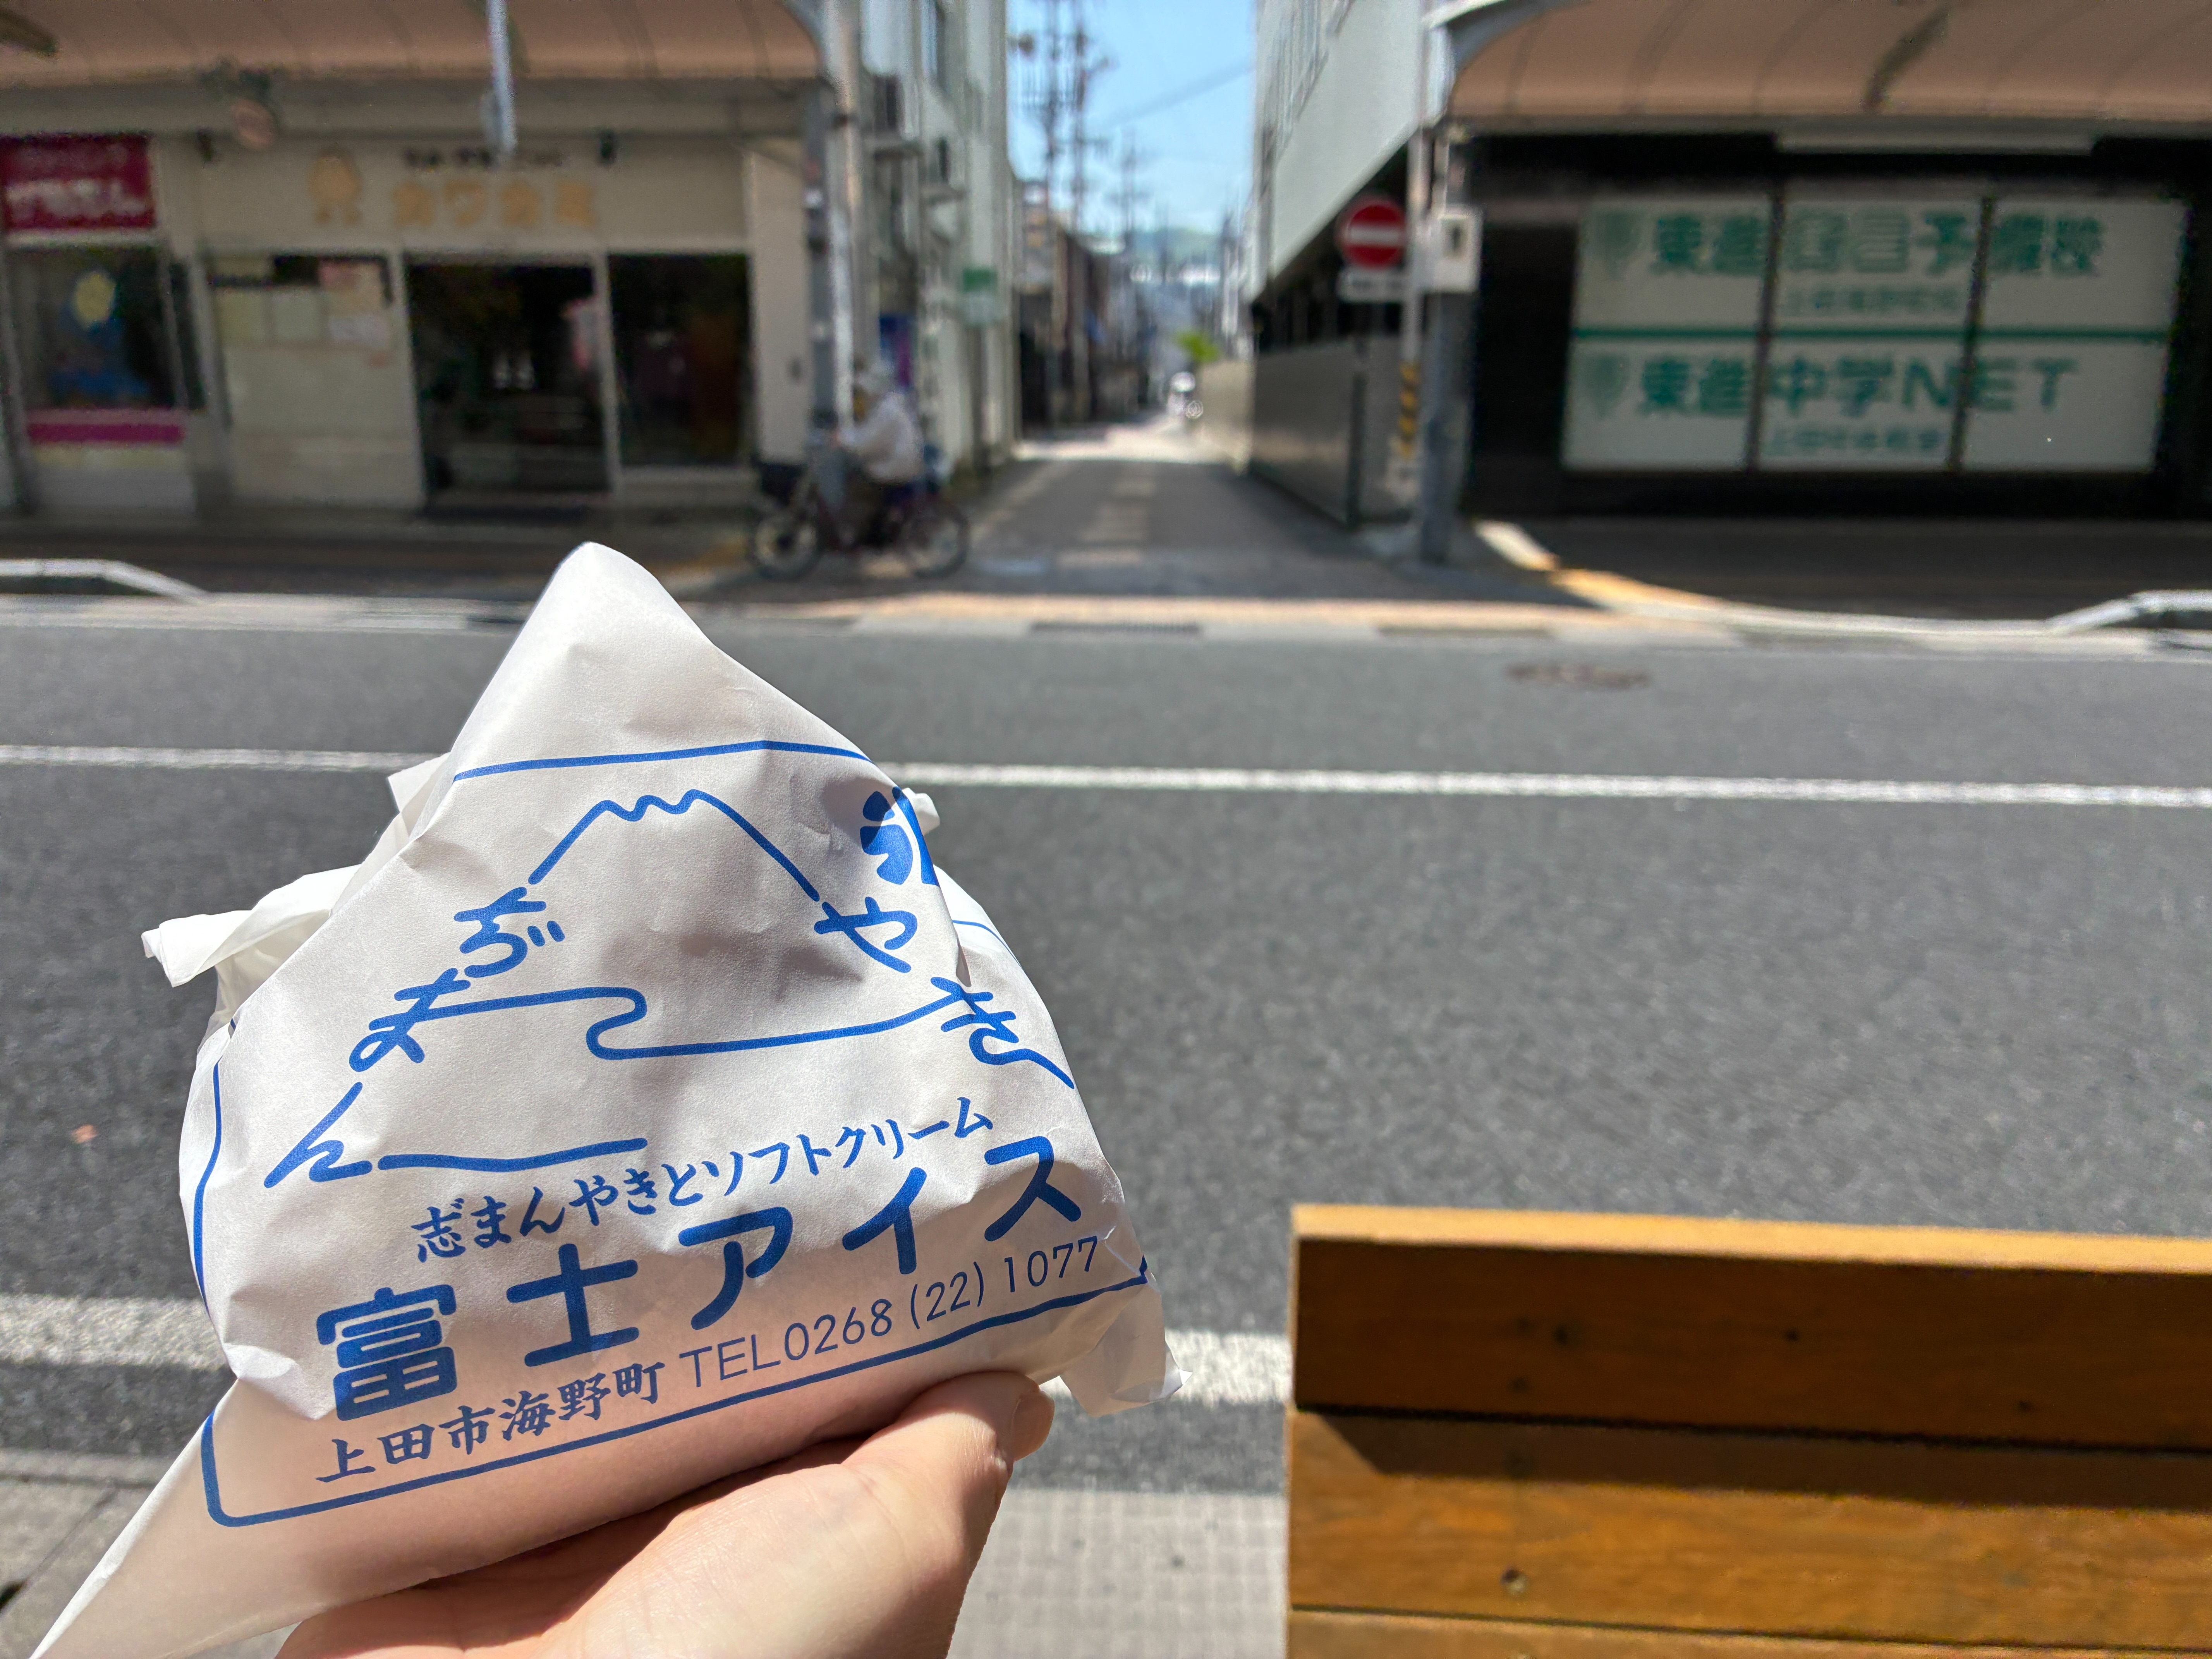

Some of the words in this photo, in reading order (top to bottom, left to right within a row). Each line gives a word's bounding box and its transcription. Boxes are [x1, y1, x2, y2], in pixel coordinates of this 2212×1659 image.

[316, 1136, 1081, 1421] 富士アイス
[316, 1362, 665, 1483] 上田市海野町
[910, 1261, 984, 1329] (22)
[1004, 1235, 1098, 1293] 1077
